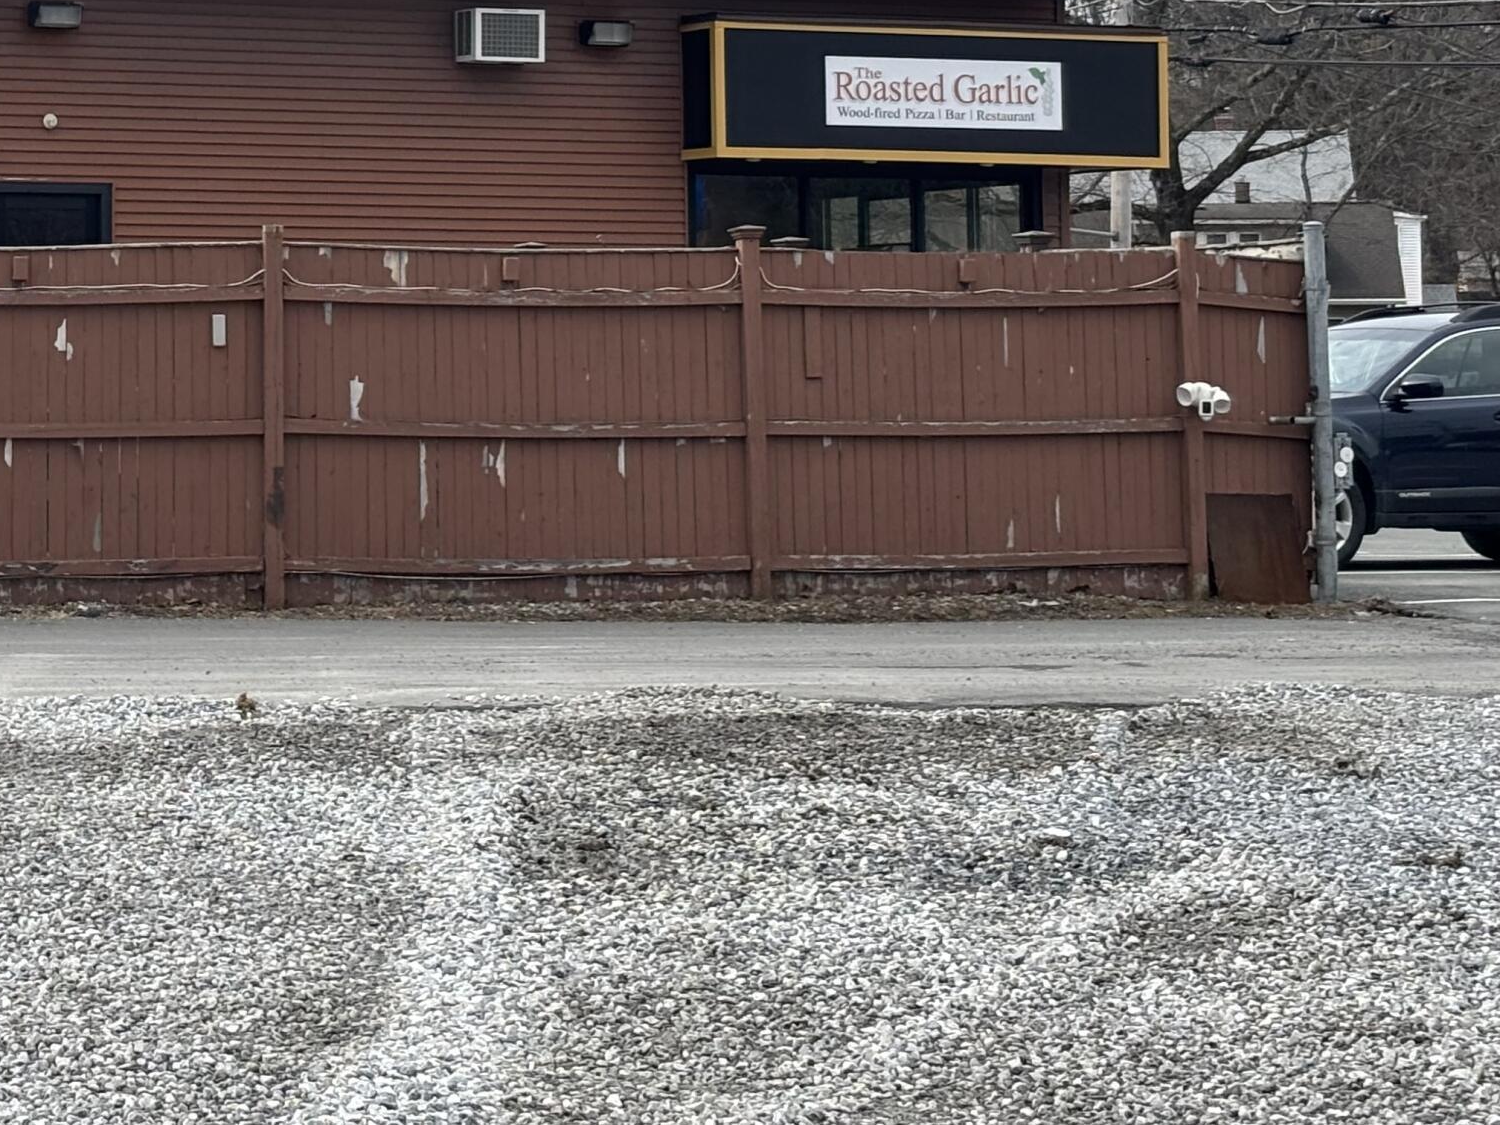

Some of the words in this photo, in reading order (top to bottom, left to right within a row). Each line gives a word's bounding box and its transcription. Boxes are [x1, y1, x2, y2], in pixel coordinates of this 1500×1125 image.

[854, 67, 882, 79] The
[833, 71, 946, 103] Roasted
[953, 74, 1039, 105] Garlic
[837, 106, 901, 119] Wood-fired
[905, 108, 935, 120] Pizza
[945, 109, 966, 121] Bar
[976, 110, 1035, 122] Restaurant
